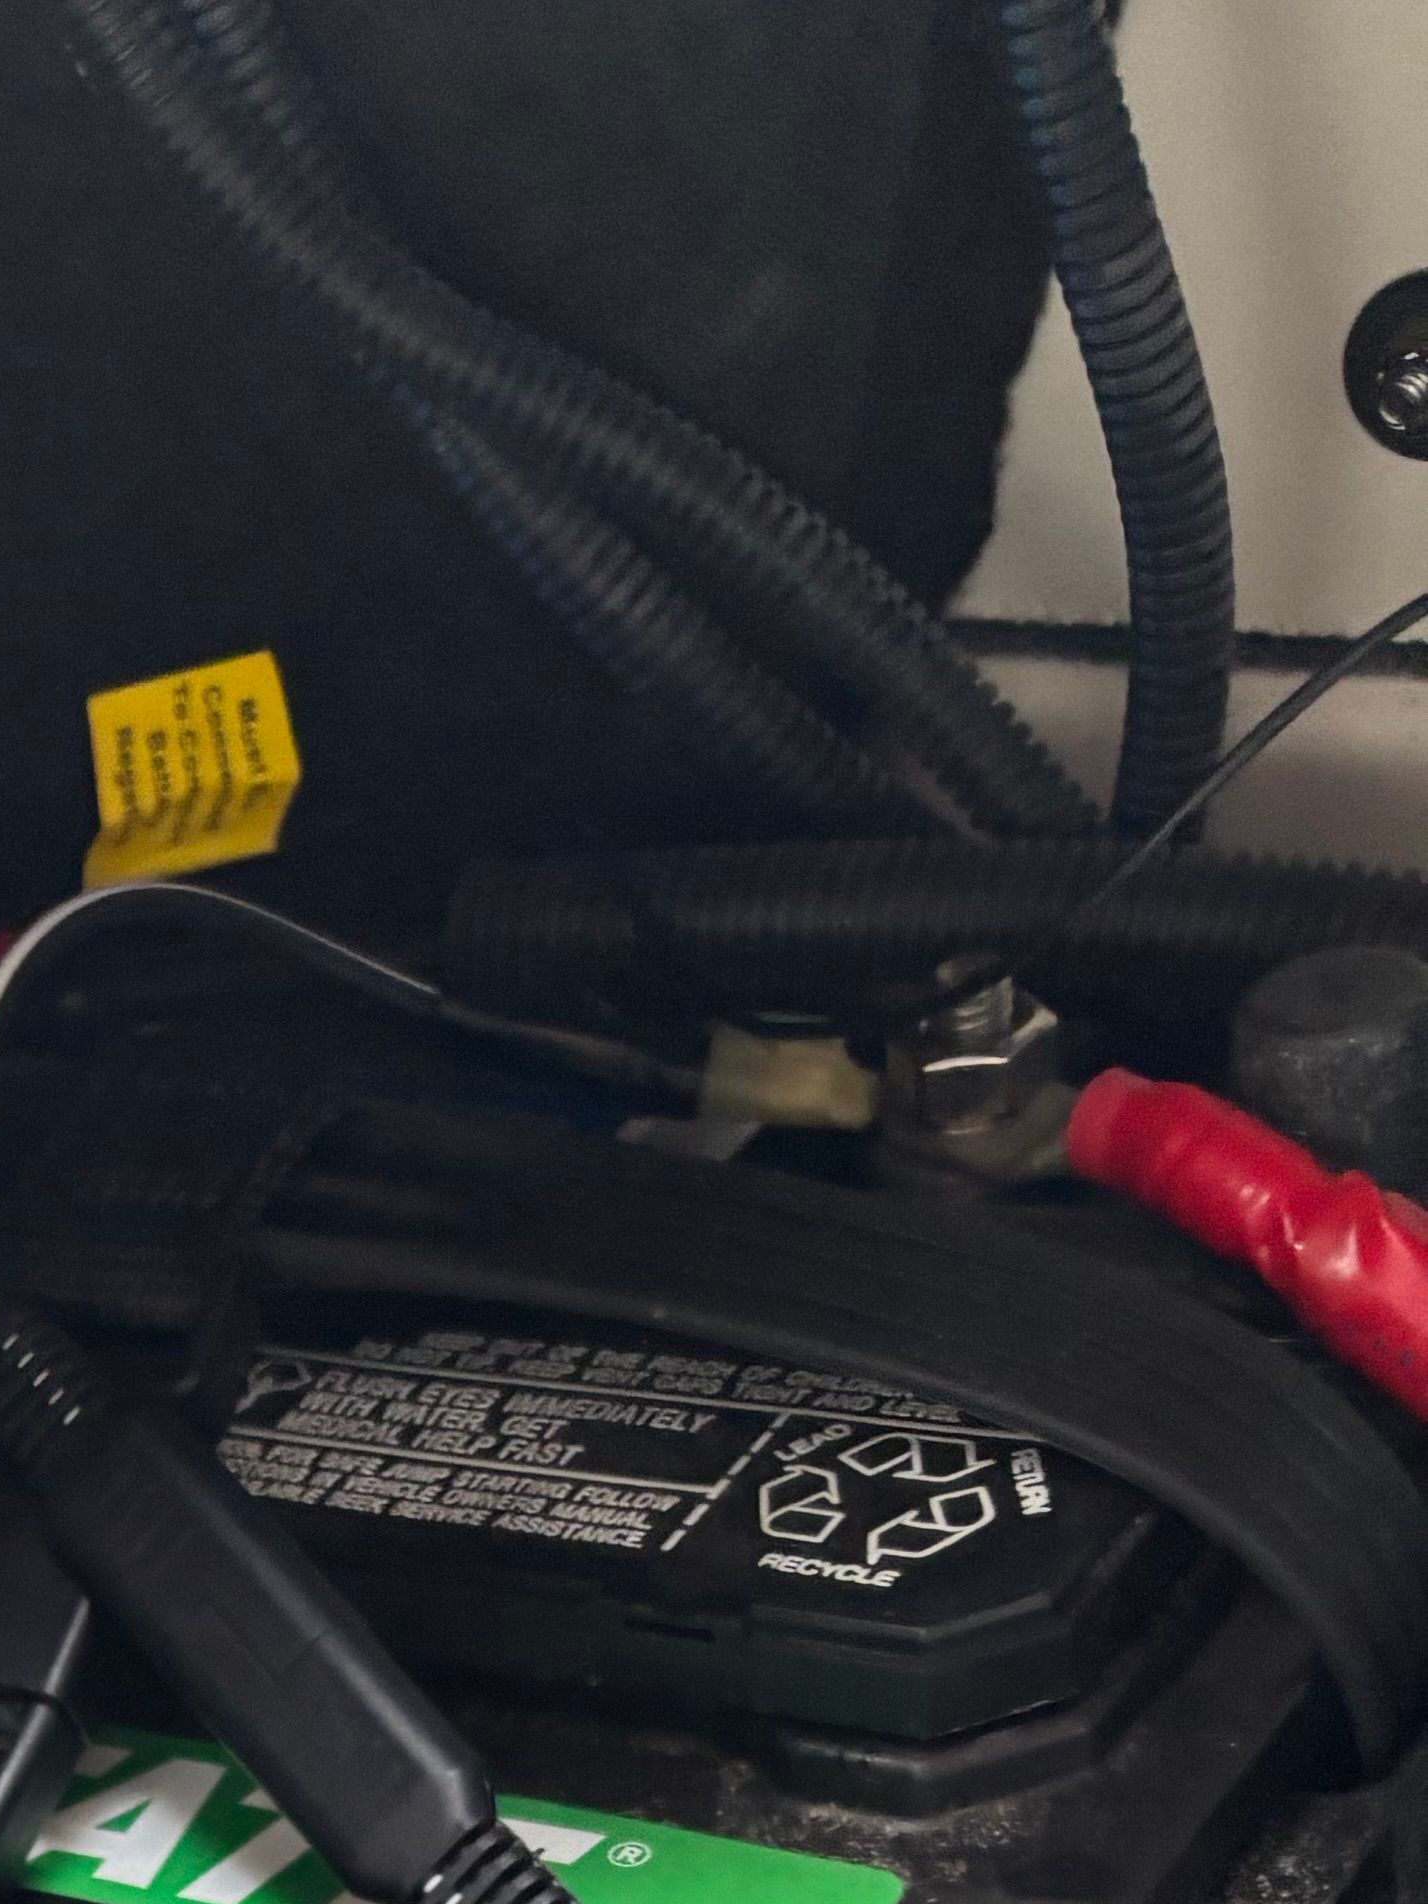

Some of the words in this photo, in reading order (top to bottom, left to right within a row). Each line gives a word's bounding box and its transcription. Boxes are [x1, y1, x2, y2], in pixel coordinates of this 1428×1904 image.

[499, 1415, 570, 1440] GET
[502, 1391, 717, 1433] IMMEDIATELY
[410, 1428, 498, 1456] HELP
[498, 1439, 587, 1466] FAST
[774, 1423, 853, 1462] LEAD
[452, 1471, 574, 1500] STARTING
[573, 1485, 682, 1512] FOLLOW
[1011, 1447, 1052, 1516] RETURN
[756, 1551, 902, 1588] RECYCLE
